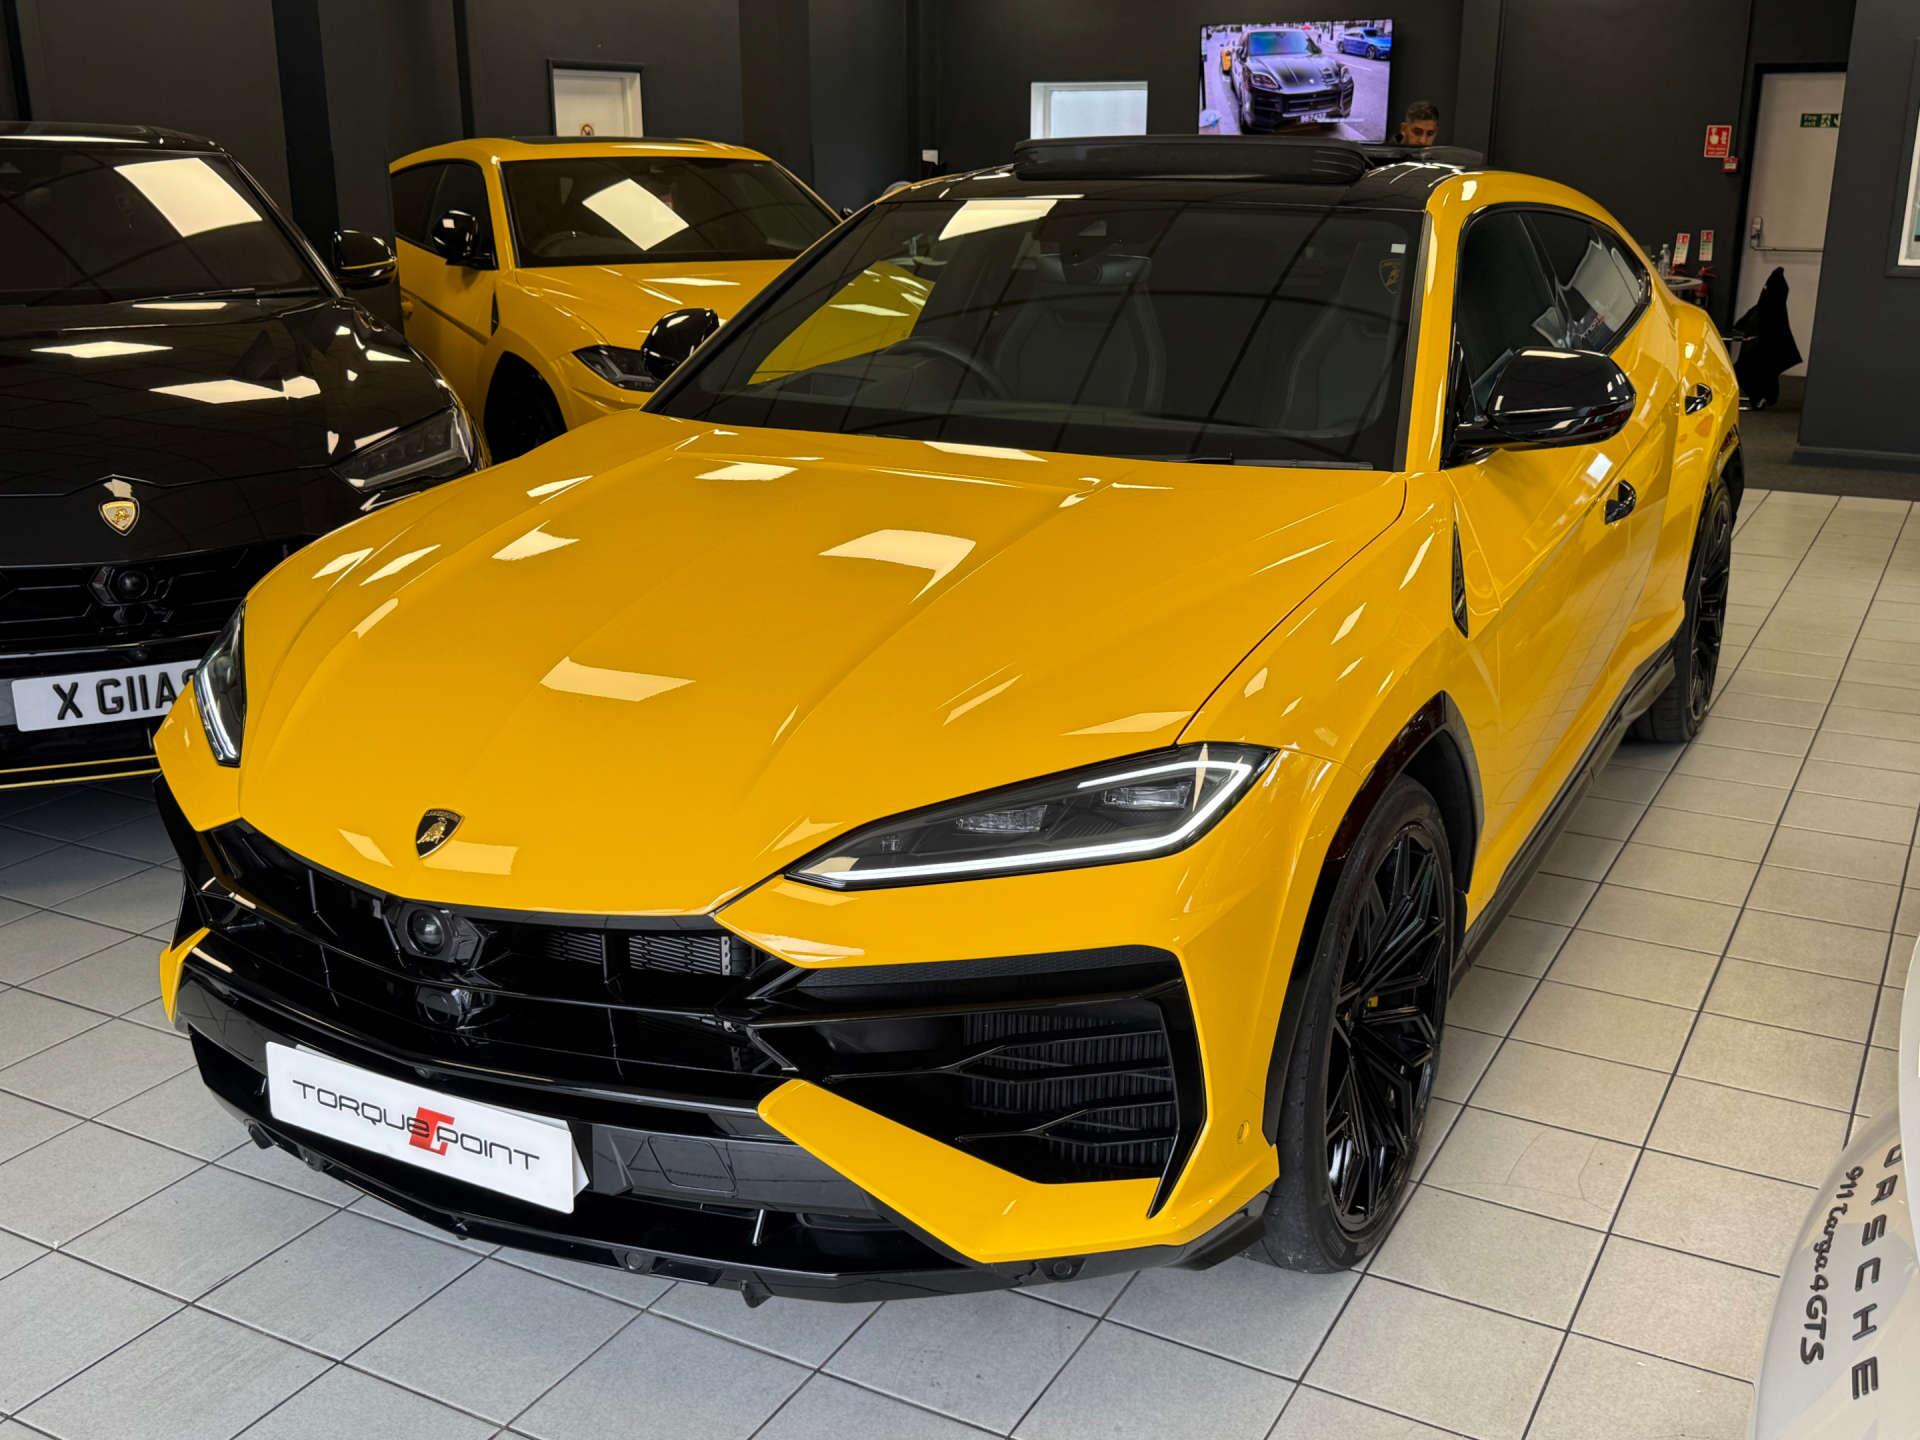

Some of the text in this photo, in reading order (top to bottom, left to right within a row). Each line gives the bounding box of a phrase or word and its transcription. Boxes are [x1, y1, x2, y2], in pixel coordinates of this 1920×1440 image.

[52, 681, 84, 721] X
[292, 1079, 541, 1170] TORQUE POINT
[1836, 1166, 1864, 1198] 911
[1813, 1203, 1848, 1272] Targa
[1852, 1143, 1902, 1400] ORSCHE
